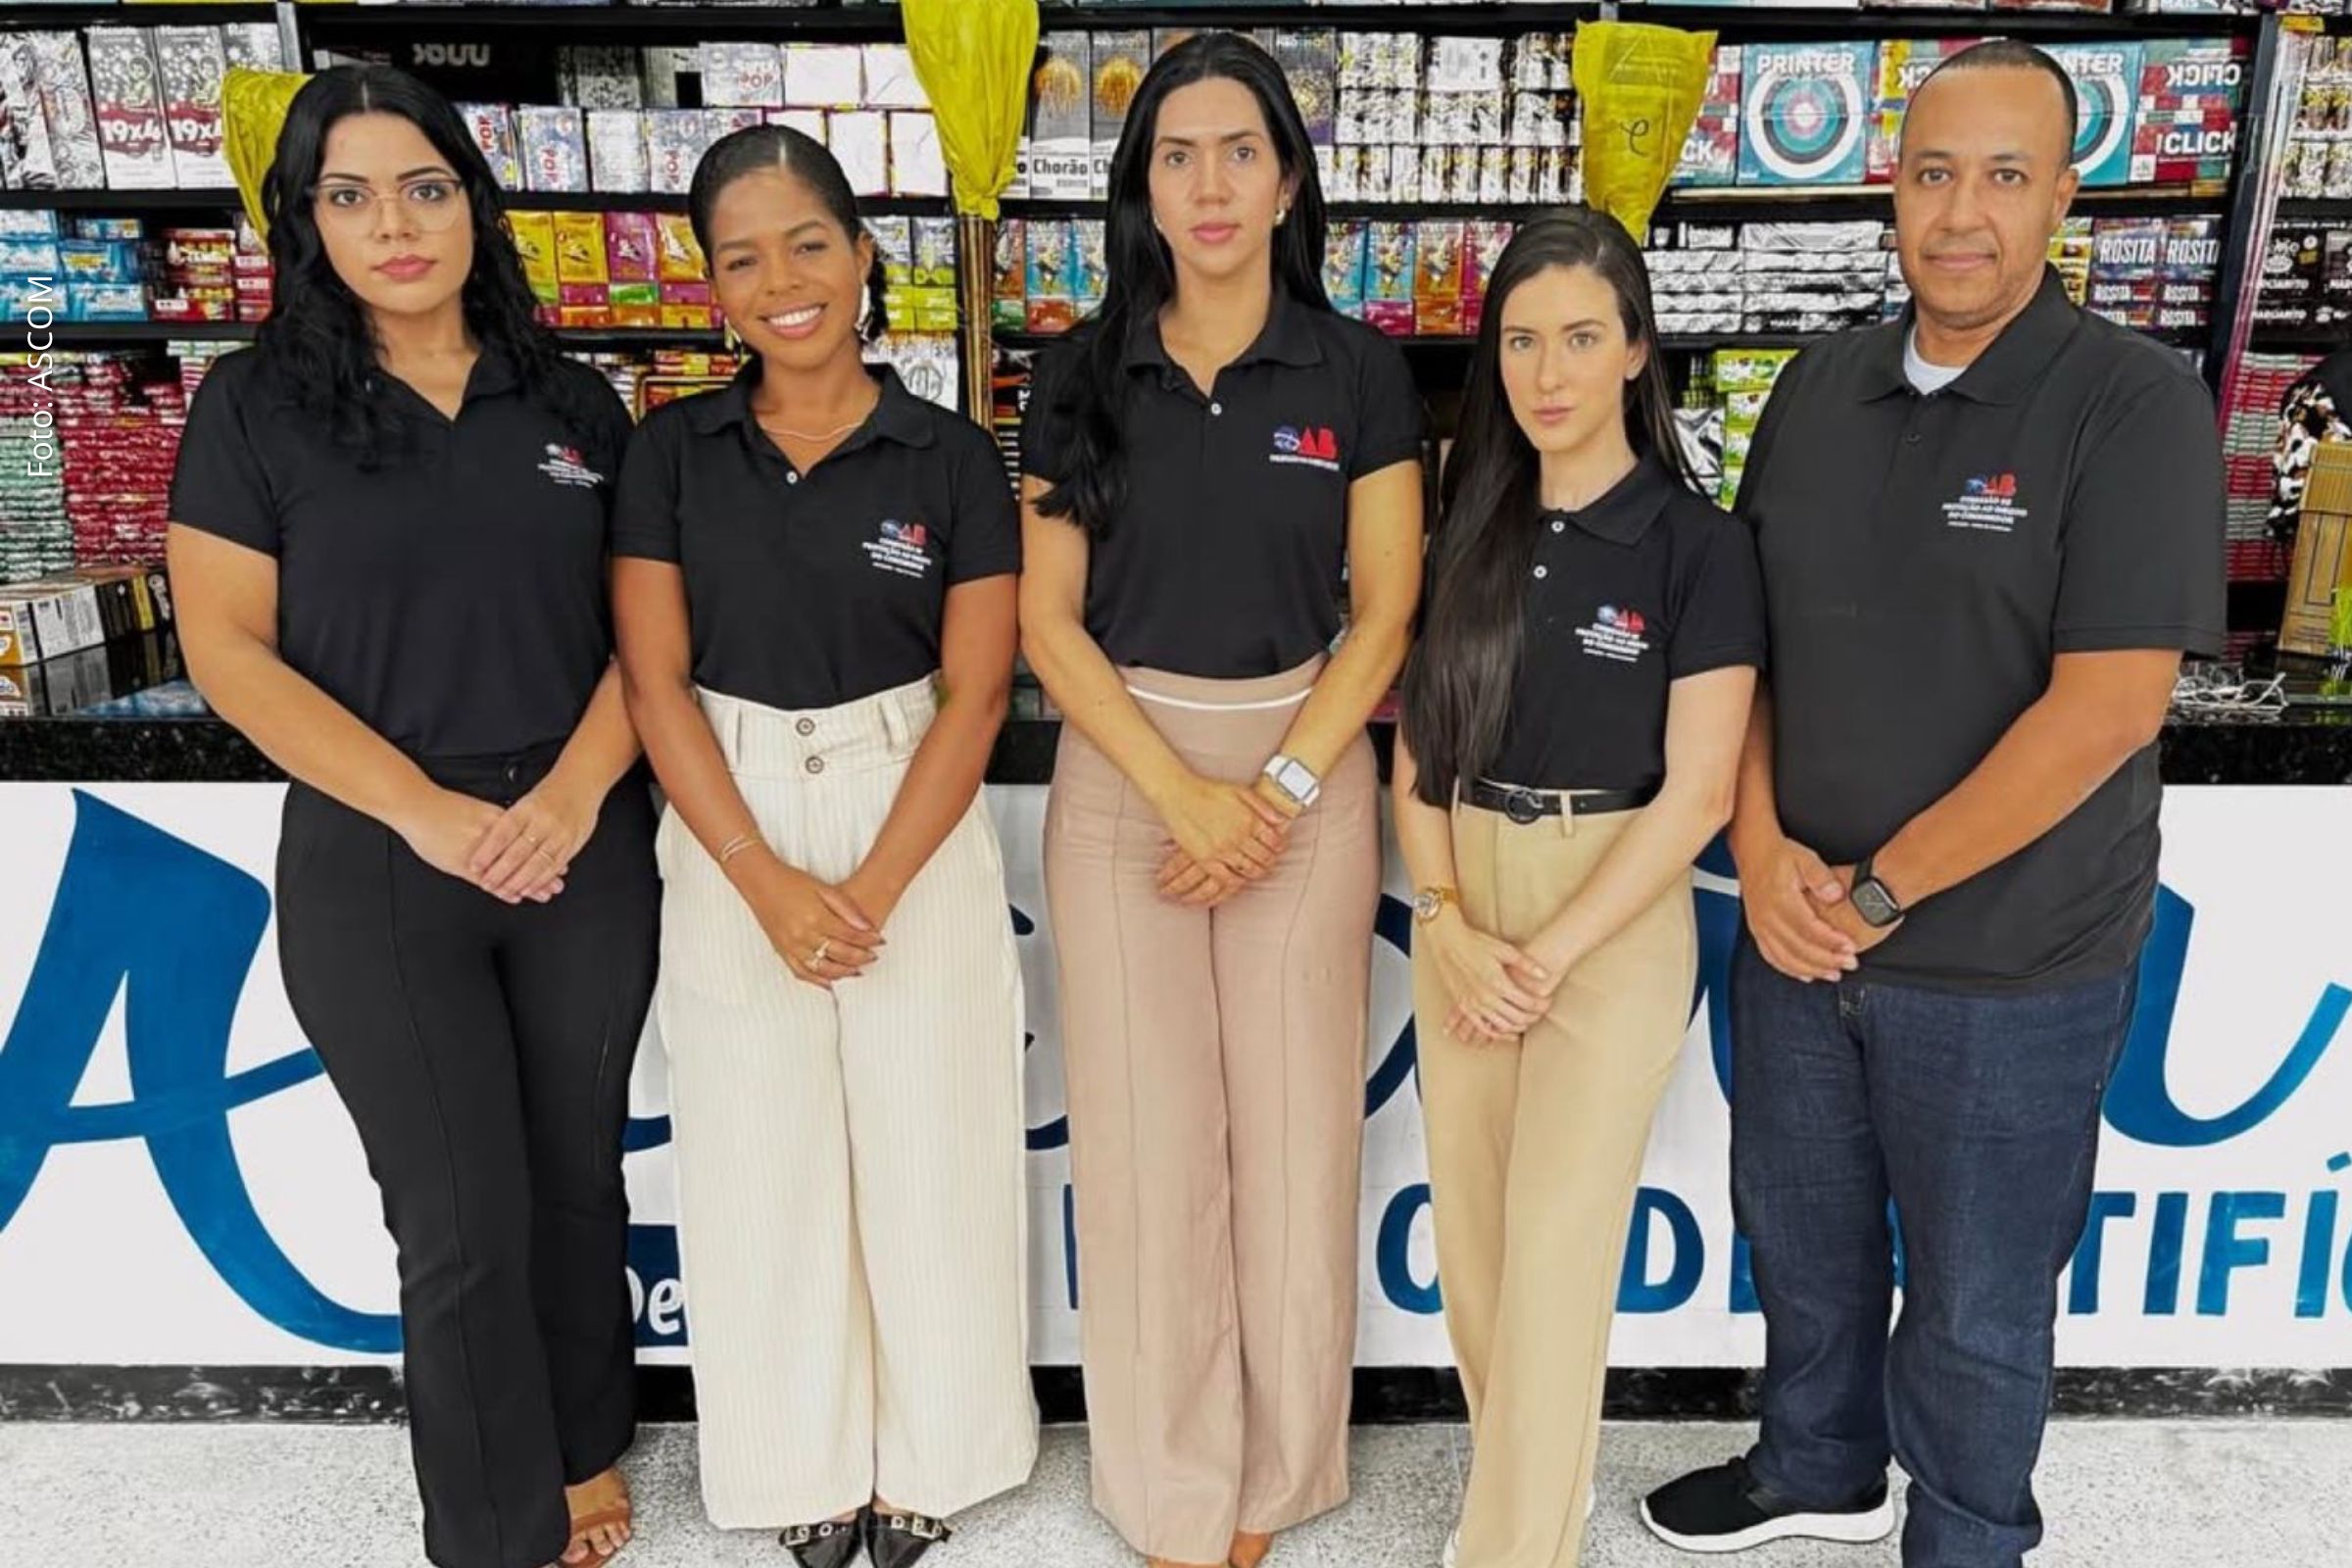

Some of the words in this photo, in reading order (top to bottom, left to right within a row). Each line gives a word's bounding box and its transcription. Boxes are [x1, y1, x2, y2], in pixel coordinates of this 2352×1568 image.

[1756, 53, 1855, 75] PRINTER
[2062, 53, 2124, 74] NTER
[2167, 64, 2241, 87] CLICK
[1033, 158, 1089, 174] Chorão
[2099, 238, 2155, 265] ROSITA
